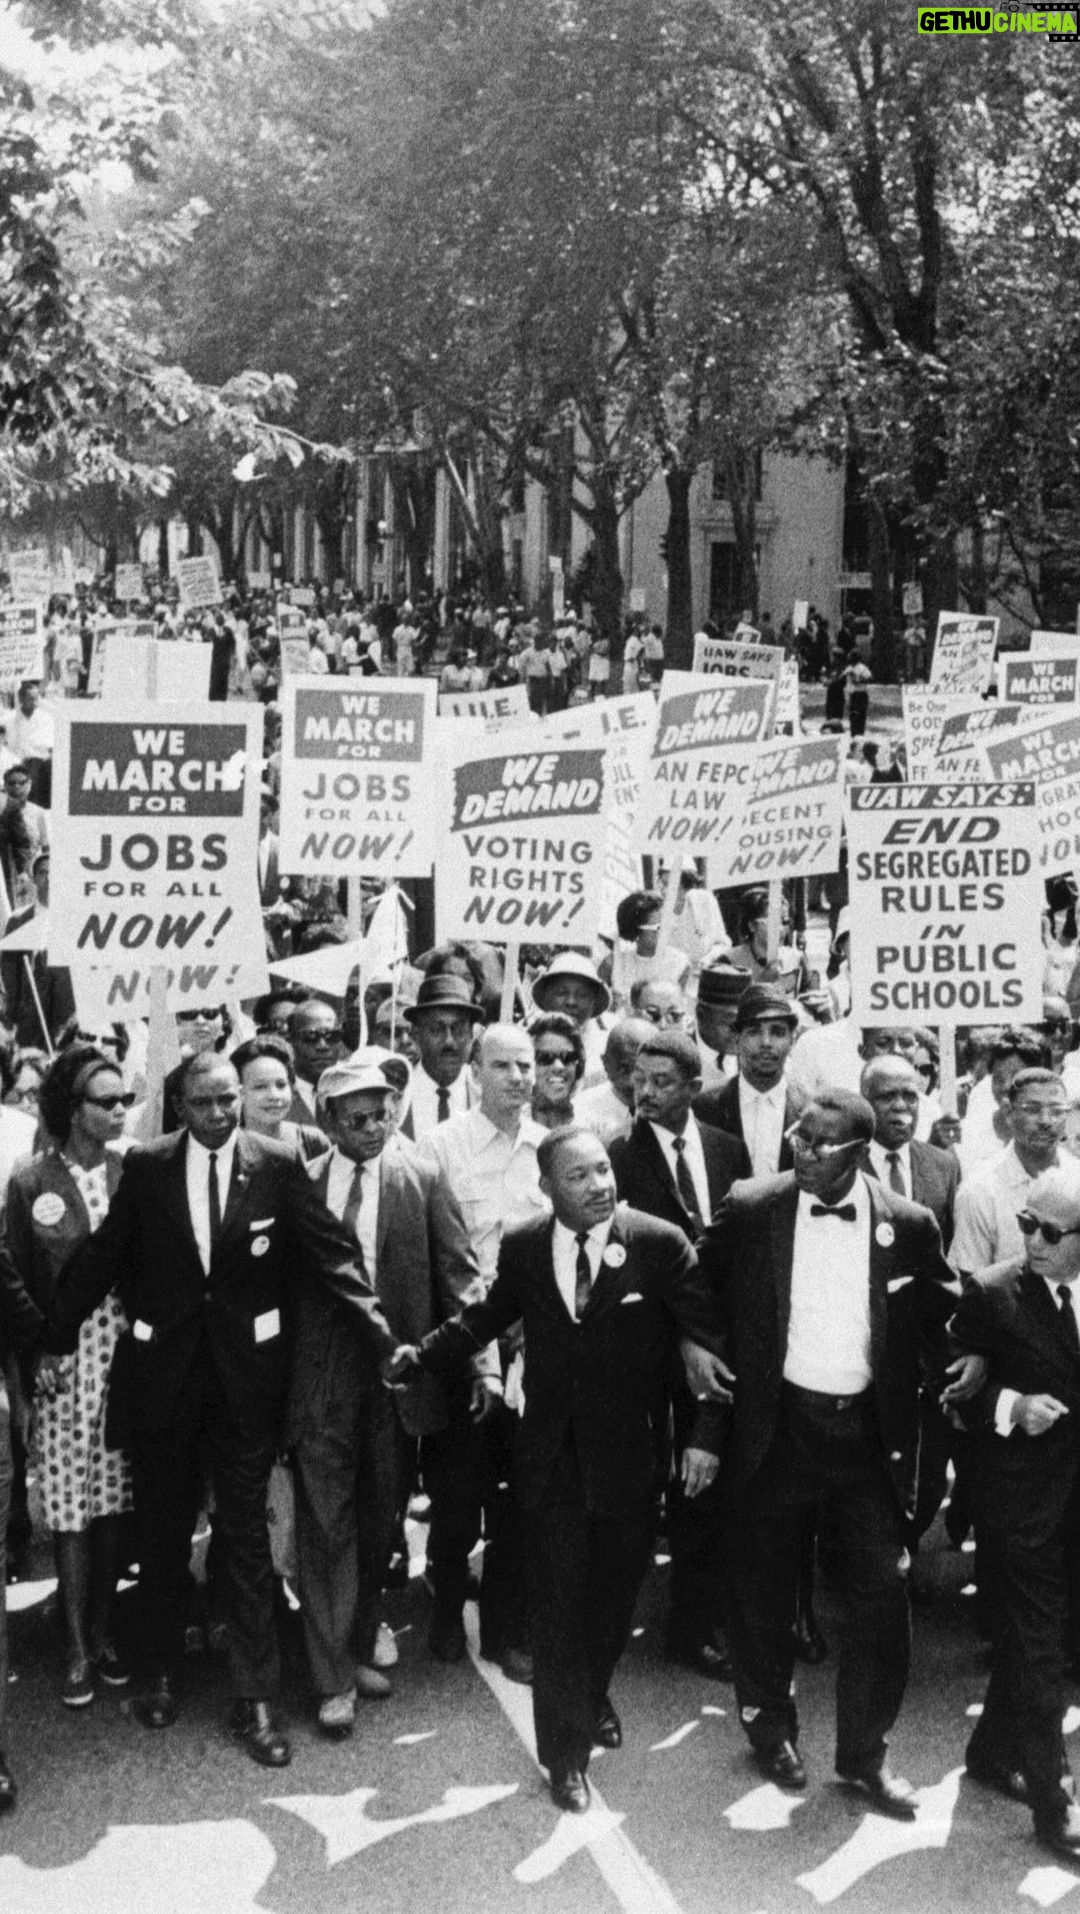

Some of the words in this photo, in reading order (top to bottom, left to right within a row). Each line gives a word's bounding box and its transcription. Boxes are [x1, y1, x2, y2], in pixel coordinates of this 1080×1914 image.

[703, 647, 737, 659] UAW
[1010, 675, 1074, 694] MARCH
[341, 695, 380, 716] WE
[694, 689, 737, 718] WE
[132, 729, 185, 756] WE
[303, 716, 415, 744] MARCH
[658, 709, 760, 750] DEMAND
[1021, 729, 1055, 751] WE
[337, 745, 382, 758] FOR
[936, 758, 959, 772] AN
[81, 759, 235, 792] MARCH
[501, 754, 560, 787] WE
[654, 762, 688, 783] AN
[697, 761, 750, 785] FEPC
[752, 759, 835, 798] MAND
[302, 772, 411, 802] JOBS
[460, 778, 600, 824] DEMAND
[670, 789, 726, 811] LAW
[857, 788, 928, 809] UAW
[933, 784, 1033, 808] SAYS:
[128, 796, 187, 812] FOR
[305, 808, 351, 821] FOR
[366, 809, 407, 822] ALL
[742, 803, 827, 826] ECENT
[648, 815, 733, 843] NOW!
[738, 824, 834, 848] OUSING
[881, 816, 1001, 845] END
[79, 832, 228, 872] JOBS
[300, 828, 415, 861] NOW!
[462, 834, 593, 864] VOTING
[729, 841, 827, 876] NOW!
[856, 848, 1032, 881] SEGREGATED
[84, 881, 147, 897] FOR
[166, 882, 222, 897] ALL
[469, 865, 584, 895] RIGHTS
[463, 896, 586, 928] NOW!
[881, 882, 1006, 913] RULES
[76, 906, 234, 950] NOW!
[920, 924, 966, 940] IN
[876, 942, 1017, 974] PUBLIC
[870, 978, 1024, 1011] SCHOOLS
